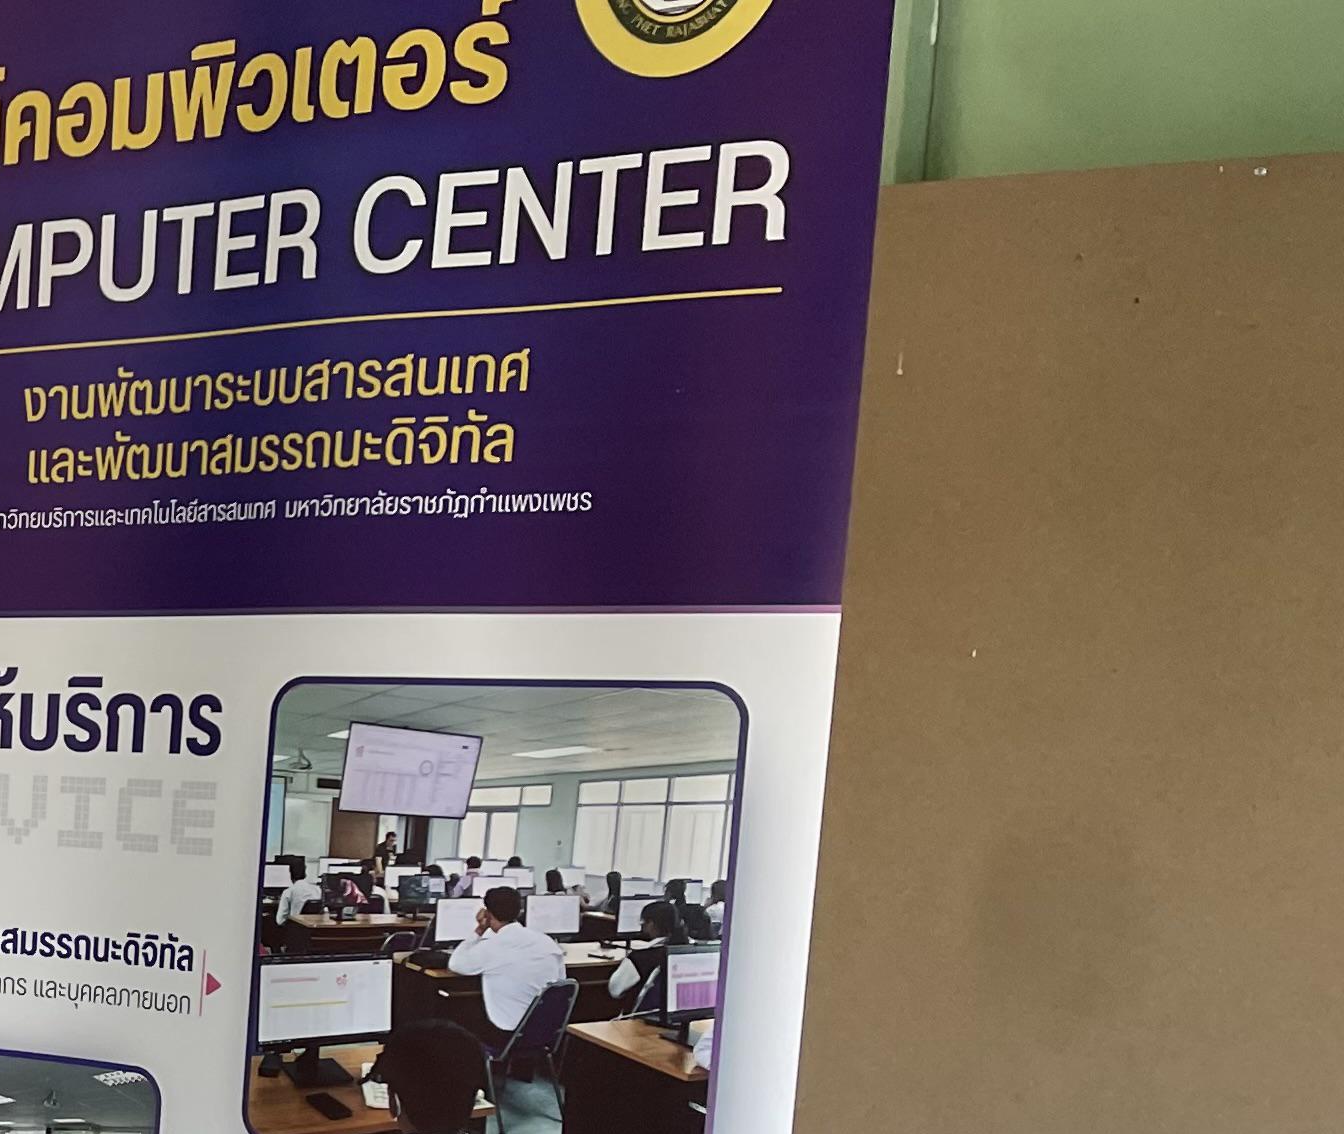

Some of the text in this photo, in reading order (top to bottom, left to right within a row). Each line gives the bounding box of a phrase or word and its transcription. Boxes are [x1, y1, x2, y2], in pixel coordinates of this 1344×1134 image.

[351, 137, 792, 277] CENTER
[24, 348, 531, 423] งานพัฒนาระบบสารสนเทศ
[27, 408, 514, 484] และพัฒนาสมรรถนะดิจิทัล
[285, 485, 592, 519] มหาวิทยาลัยราชภัฏกำแพงเพชร
[33, 976, 191, 1014] และบุคคลภายนอก
